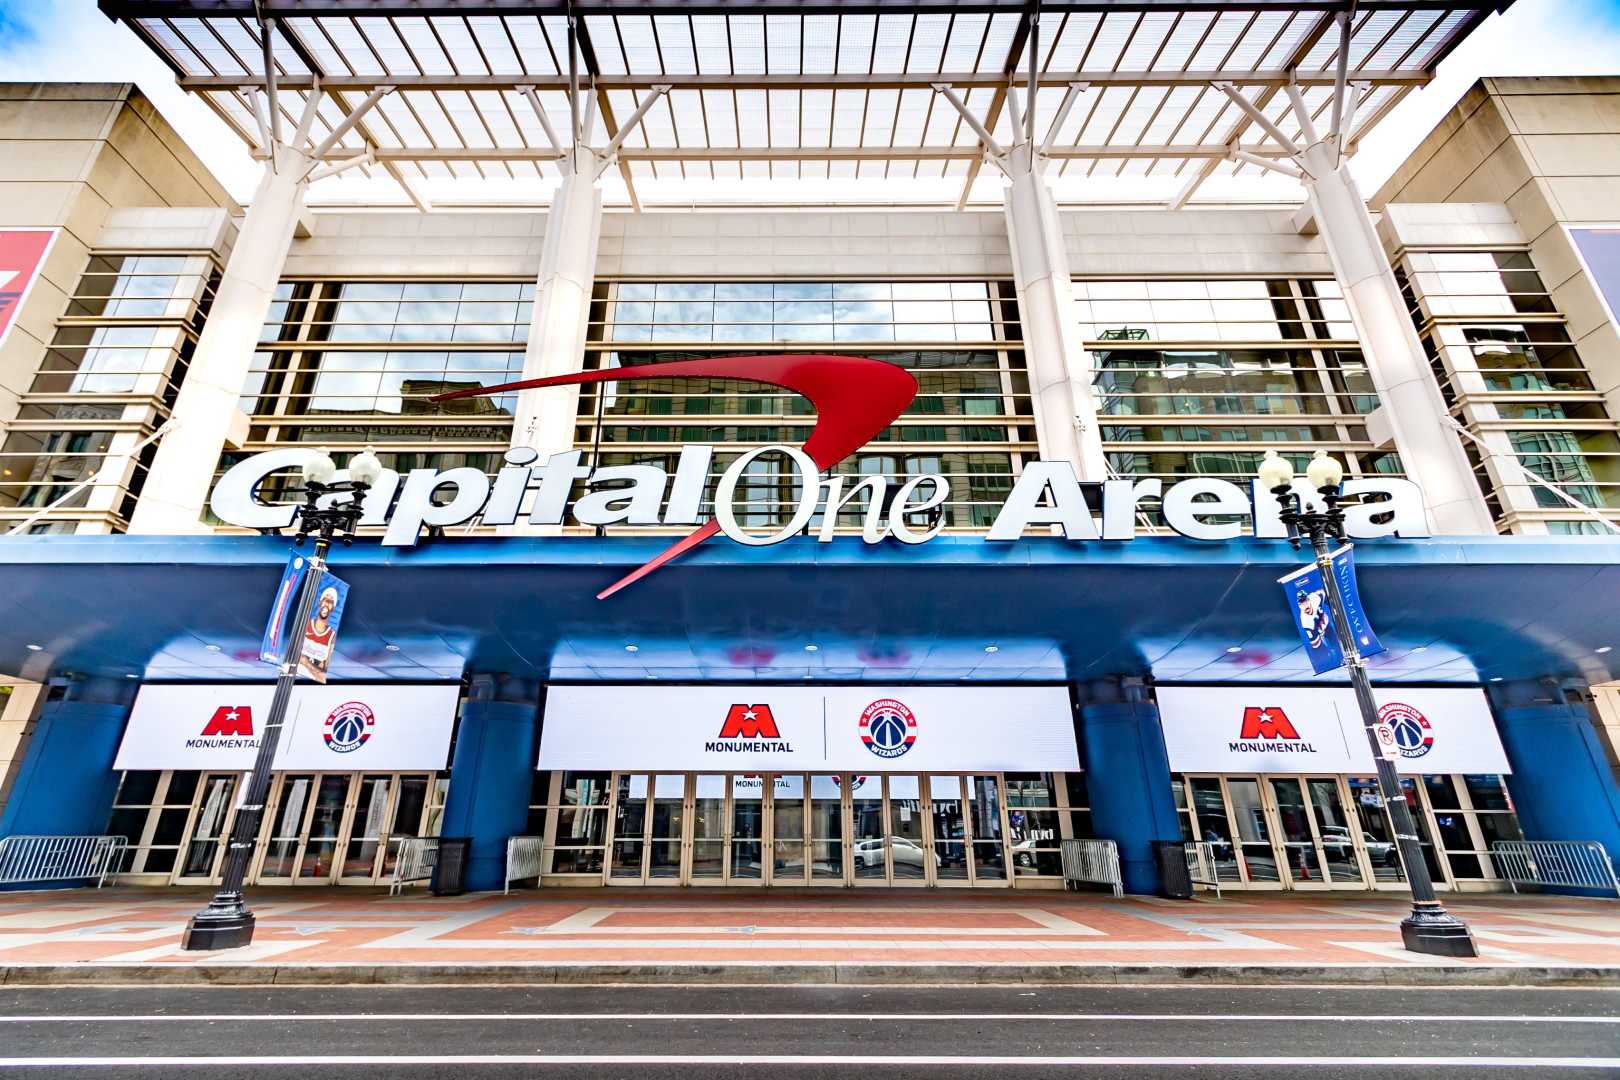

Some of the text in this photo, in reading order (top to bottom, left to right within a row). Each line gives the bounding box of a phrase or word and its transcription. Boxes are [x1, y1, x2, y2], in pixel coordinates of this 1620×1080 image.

[210, 444, 1433, 546] Capital One Arena
[865, 700, 911, 717] WASHINGTON
[185, 739, 261, 749] MONUMENTAL
[705, 742, 794, 752] MONUMENTAL
[1228, 742, 1317, 752] MONUMENTAL
[871, 744, 908, 757] WIZARDS
